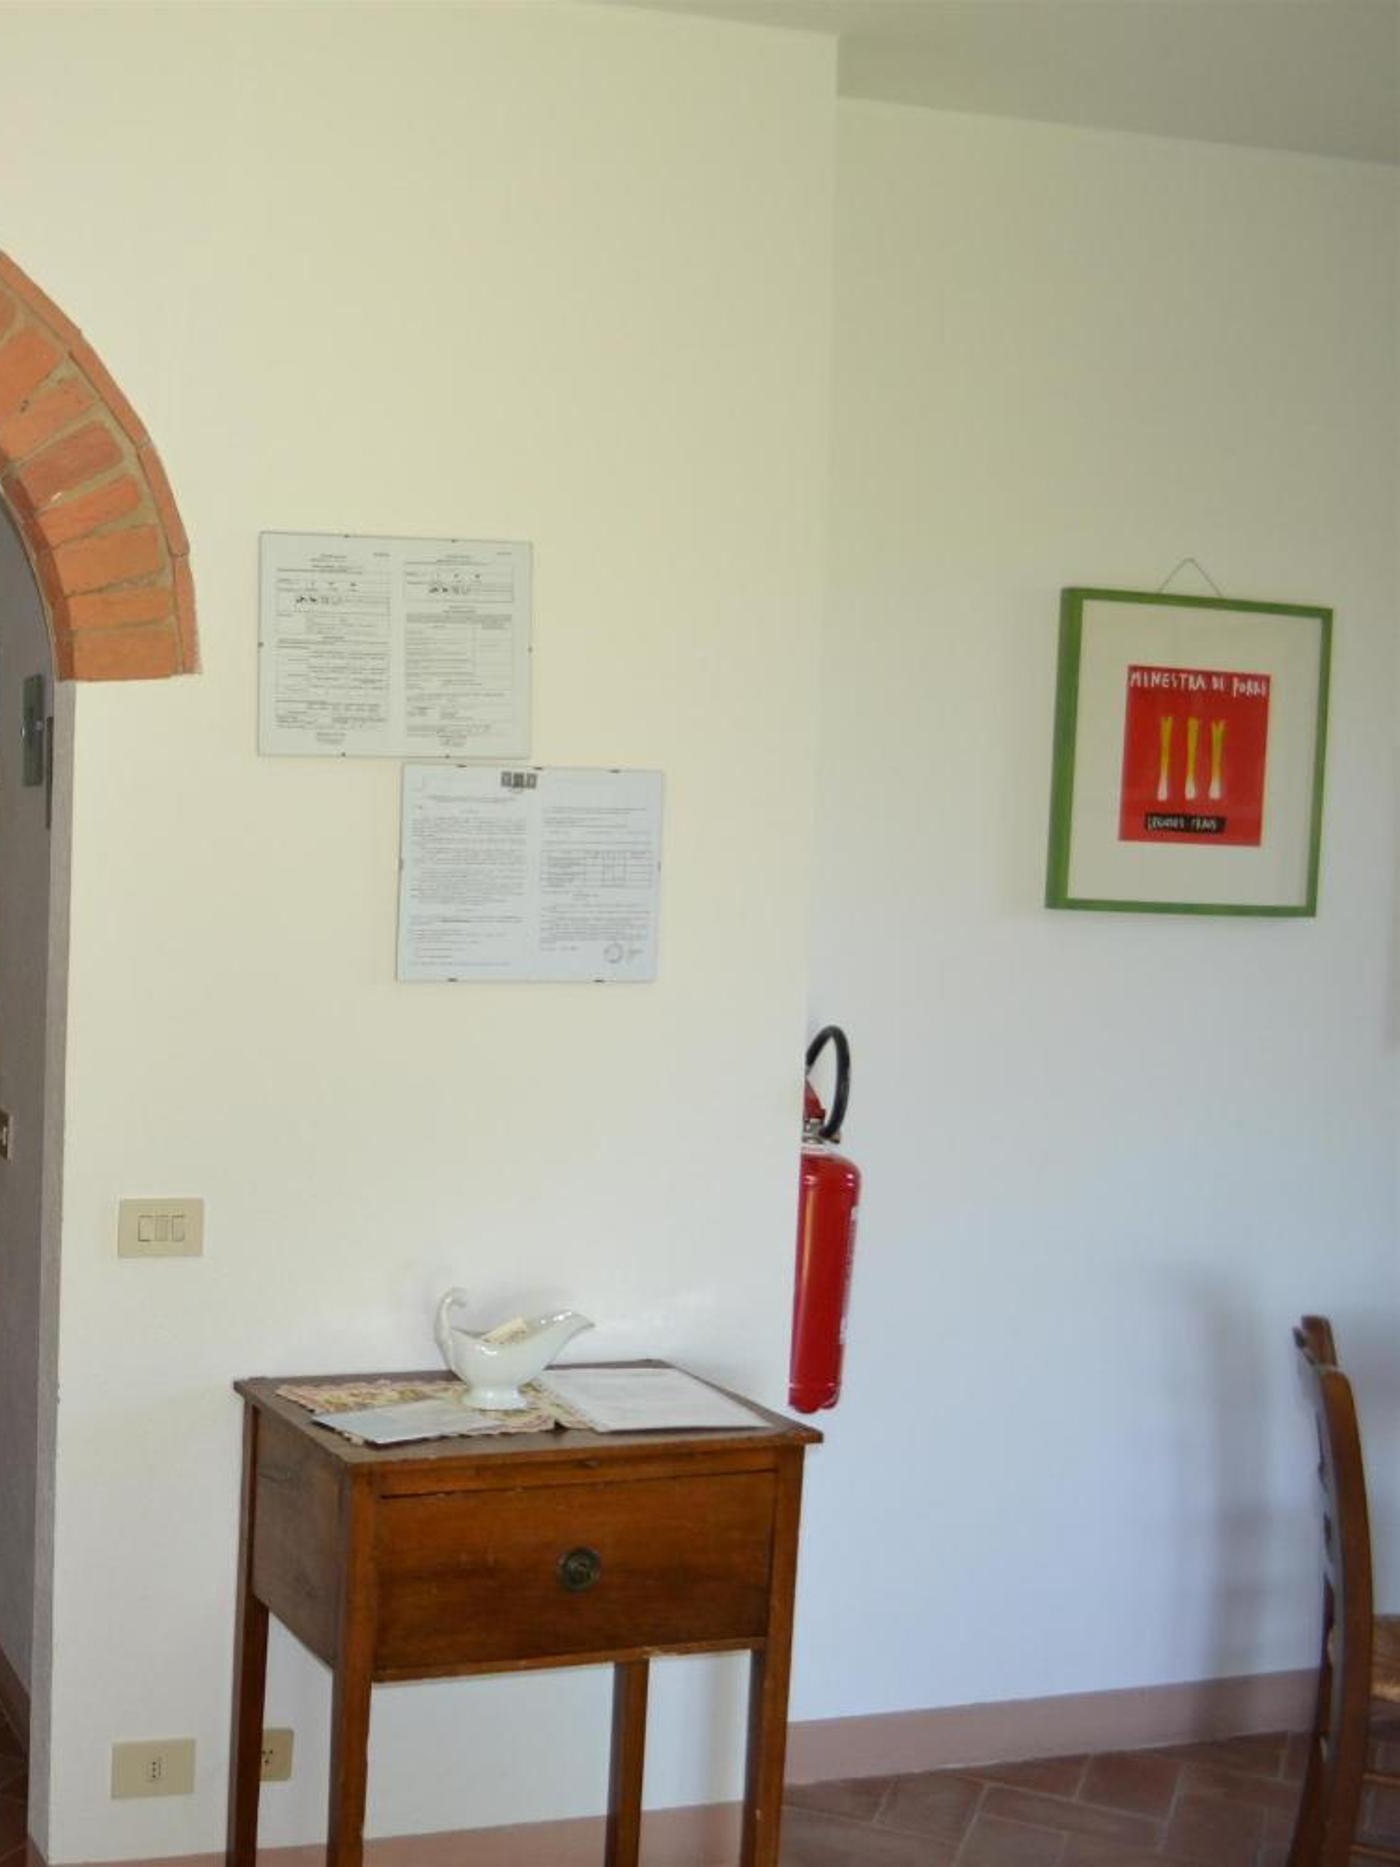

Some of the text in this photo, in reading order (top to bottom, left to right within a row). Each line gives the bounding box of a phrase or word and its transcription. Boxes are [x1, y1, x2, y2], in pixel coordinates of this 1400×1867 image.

[1130, 671, 1267, 698] MINESTRA DI PORRI
